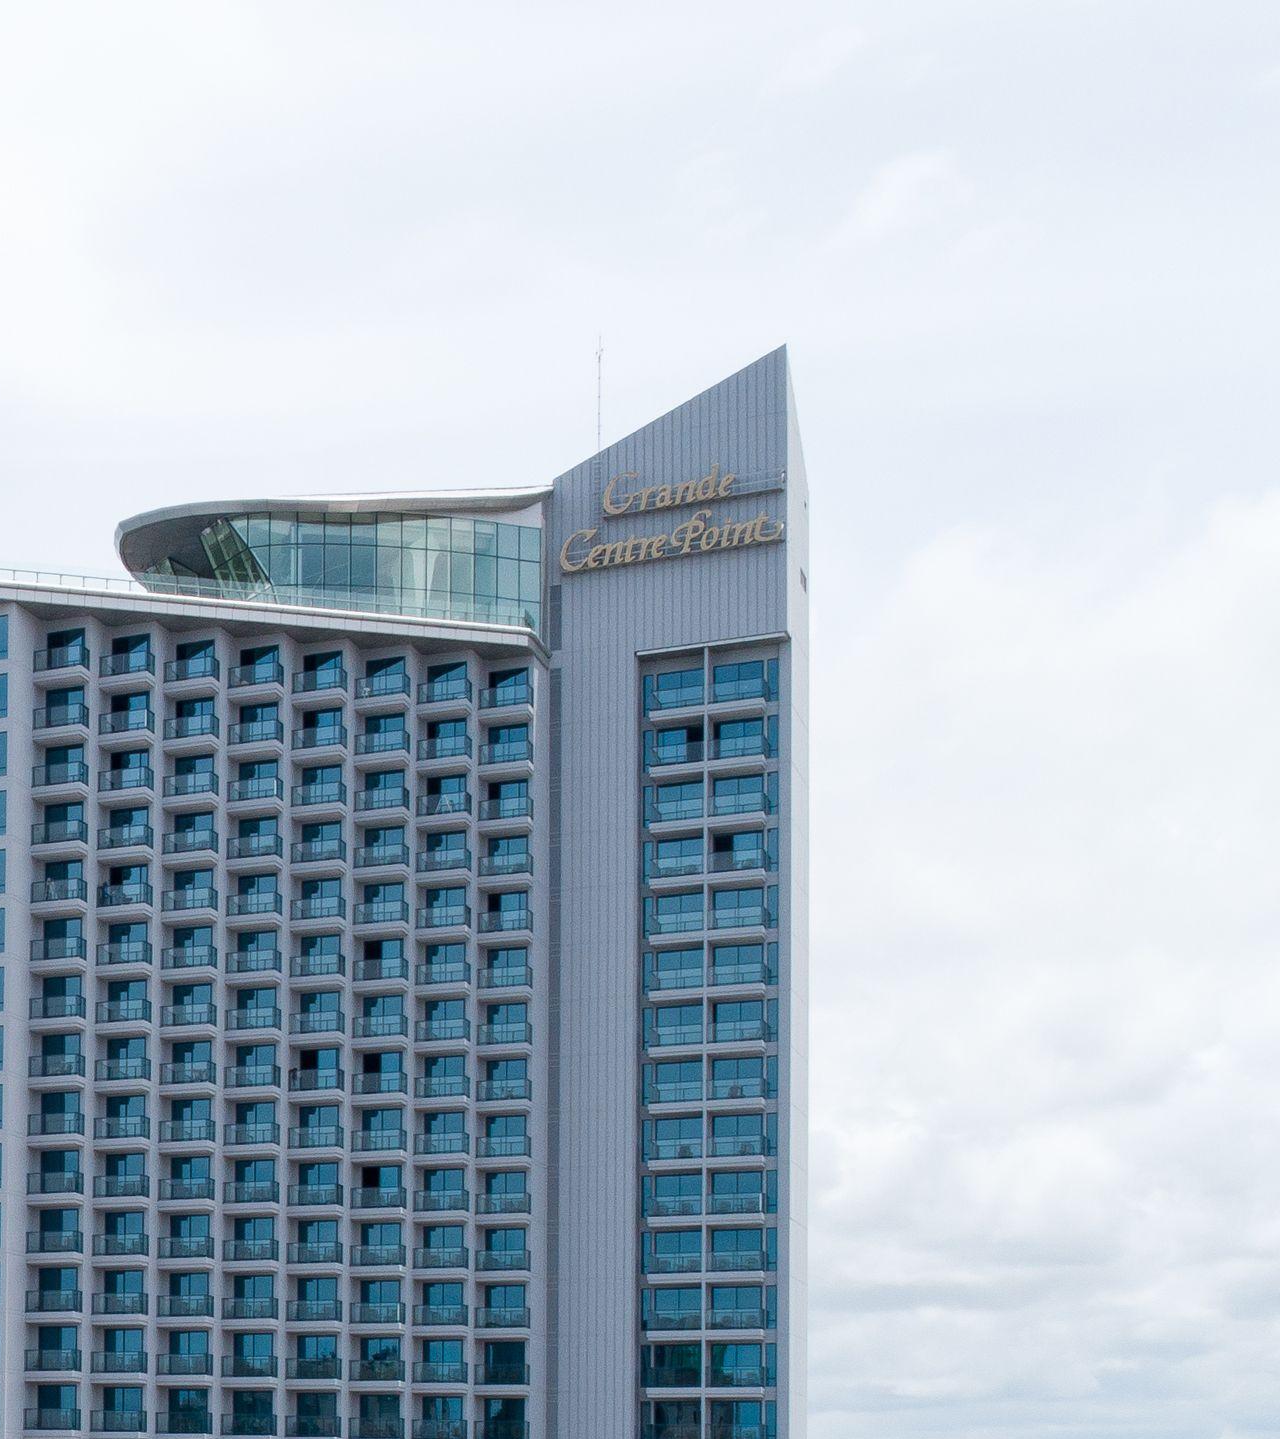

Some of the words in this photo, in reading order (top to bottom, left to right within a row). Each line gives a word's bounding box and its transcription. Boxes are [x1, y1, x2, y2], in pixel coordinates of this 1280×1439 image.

[602, 463, 736, 515] Grande
[560, 528, 668, 573] Centre
[671, 509, 784, 553] Point
